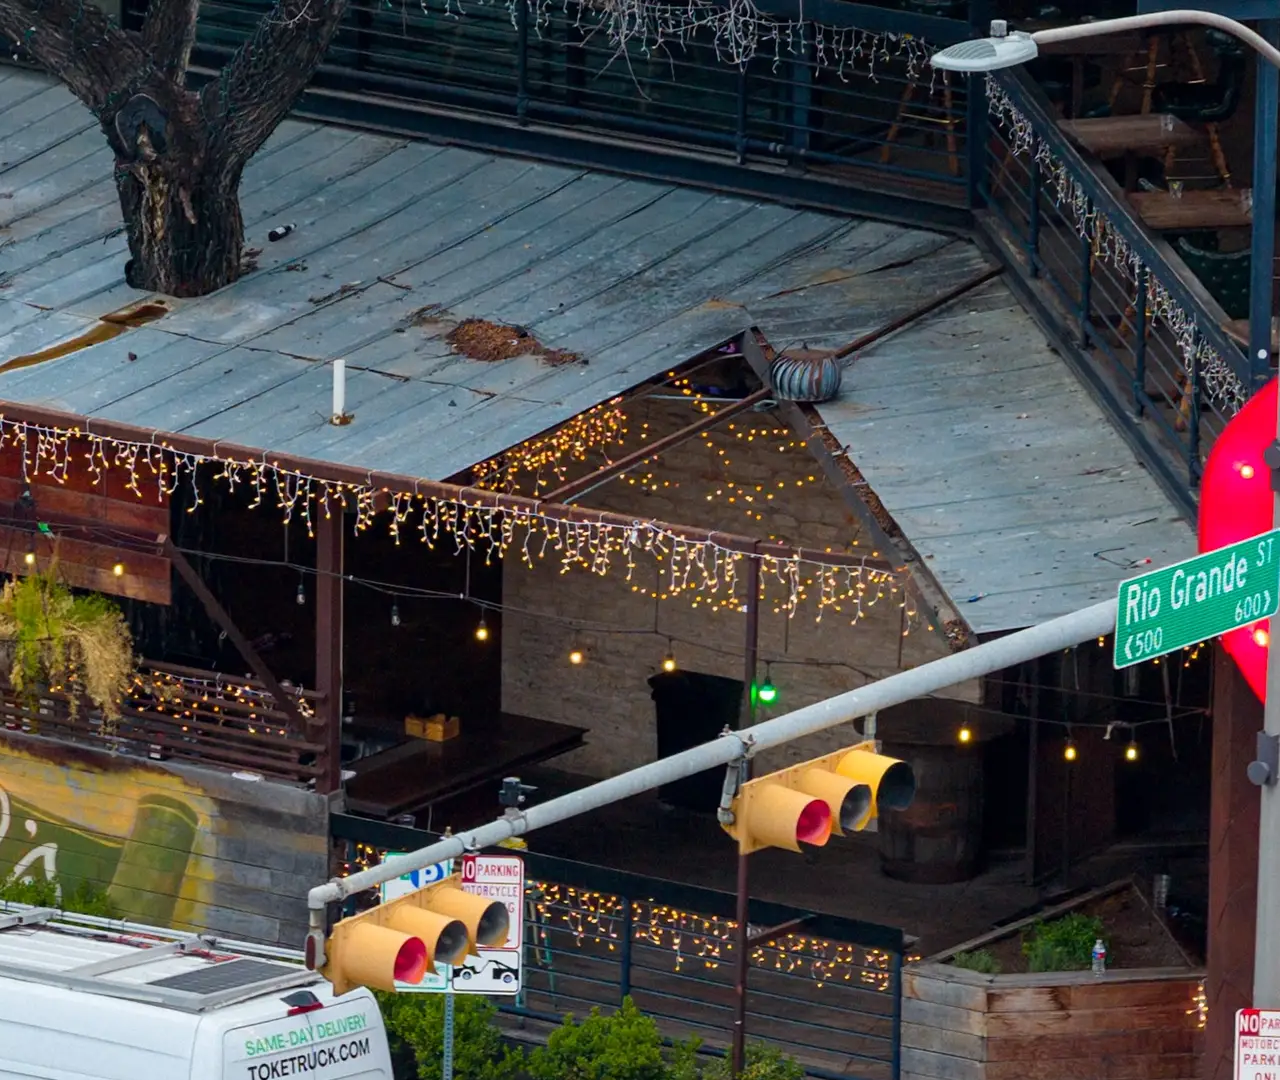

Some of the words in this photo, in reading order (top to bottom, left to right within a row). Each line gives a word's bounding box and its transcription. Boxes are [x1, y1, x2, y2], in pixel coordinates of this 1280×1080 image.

[1125, 581, 1161, 626] Rio
[1171, 552, 1248, 610] Grande
[1257, 538, 1275, 567] ST
[1234, 593, 1261, 622] 600
[1136, 627, 1163, 657] 500
[477, 864, 519, 877] PARKING
[244, 1027, 315, 1056] SAME-DAY
[317, 1012, 368, 1038] DELIVERY
[1240, 1015, 1259, 1033] NO
